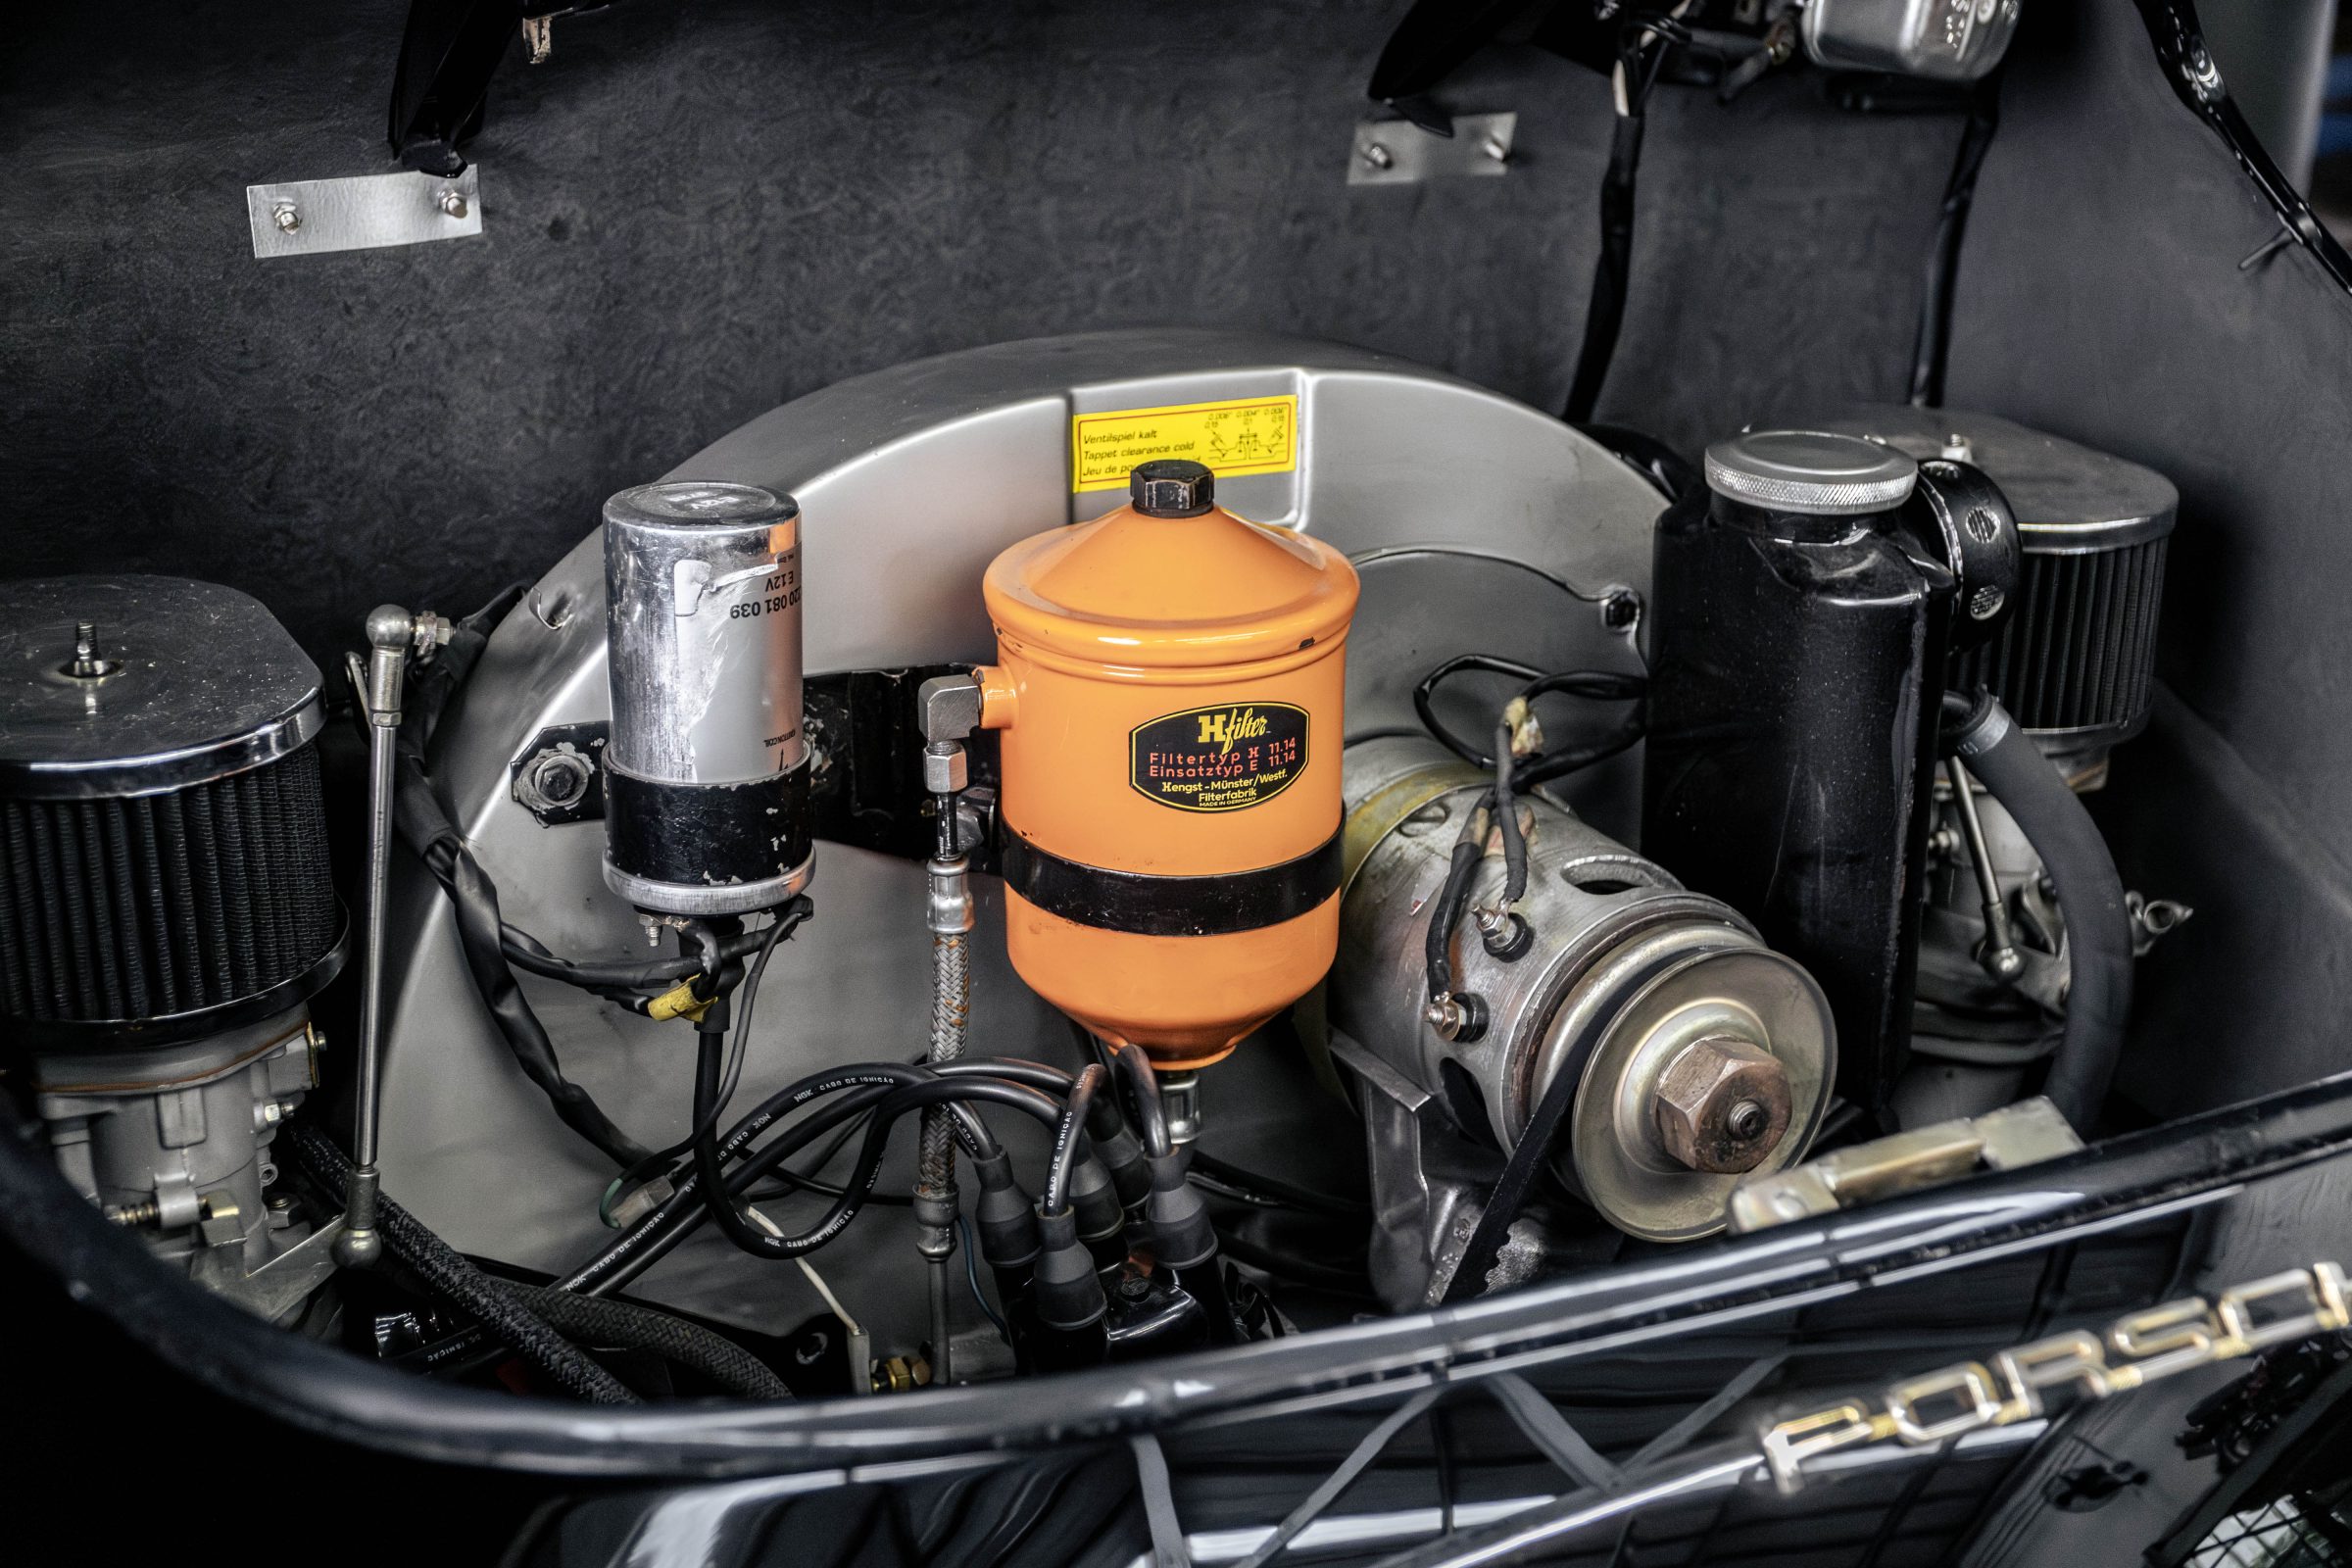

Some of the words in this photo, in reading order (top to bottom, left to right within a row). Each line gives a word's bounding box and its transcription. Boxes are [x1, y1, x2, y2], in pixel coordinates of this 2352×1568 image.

[1084, 431, 1135, 444] Ventilspiel
[1139, 429, 1157, 439] kalt
[1083, 450, 1117, 461] Tappet
[1121, 445, 1170, 457] clearance
[1173, 440, 1195, 452] cold
[1083, 466, 1102, 476] Jeu
[1104, 465, 1116, 473] de
[730, 602, 760, 619] 039
[764, 595, 788, 613] 081
[1150, 752, 1241, 765] Filtertyp
[1268, 737, 1296, 754] 11.14
[1150, 763, 1244, 777] Einsatztyp
[1250, 760, 1258, 771] E
[1268, 750, 1296, 767] 11.14
[1199, 788, 1257, 802] Filterfabrik
[794, 1089, 813, 1102] NGK
[819, 1080, 842, 1090] CABO
[1048, 1176, 1056, 1206] CABO
[1053, 1155, 1060, 1169] DE
[786, 1239, 808, 1248] CABO
[593, 1253, 615, 1272] CABO
[618, 1239, 631, 1253] DE
